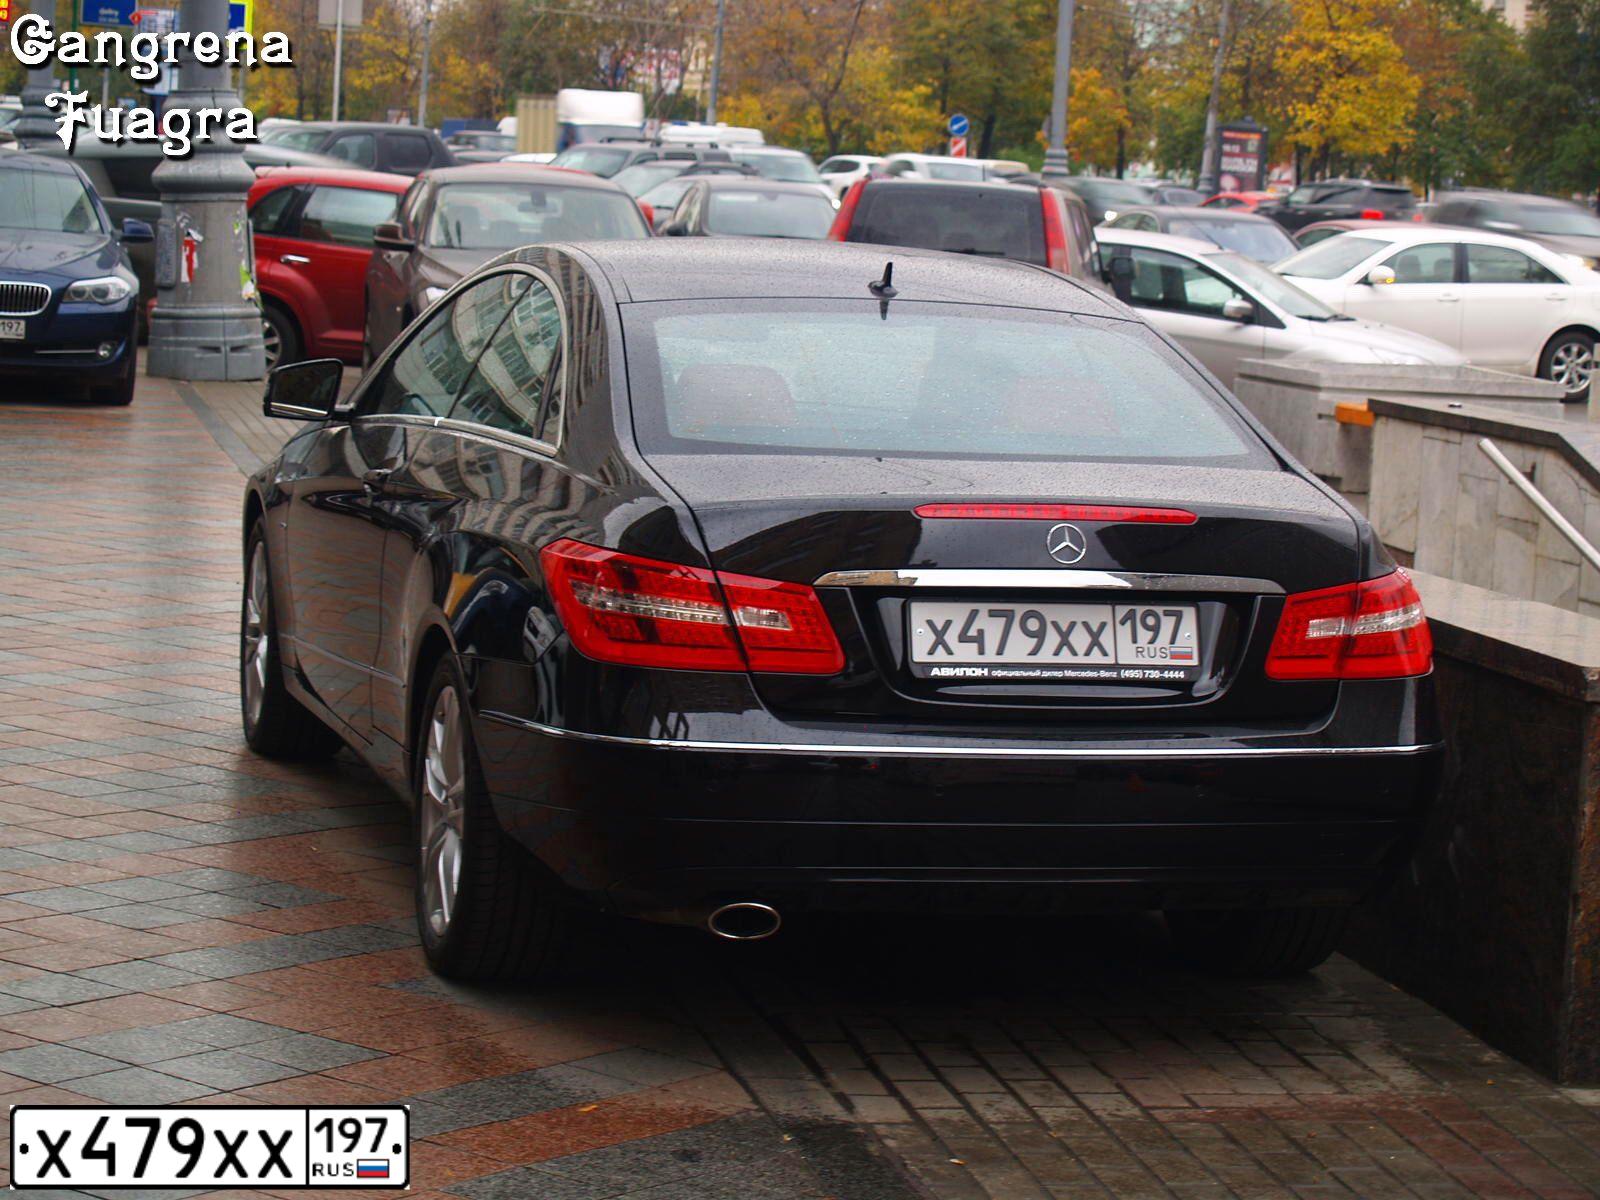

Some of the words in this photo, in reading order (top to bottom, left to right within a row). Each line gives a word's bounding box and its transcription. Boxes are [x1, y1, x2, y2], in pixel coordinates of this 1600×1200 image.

[1119, 607, 1184, 645] 197
[1135, 645, 1168, 659] RUS
[930, 667, 989, 677] АВИЛОН
